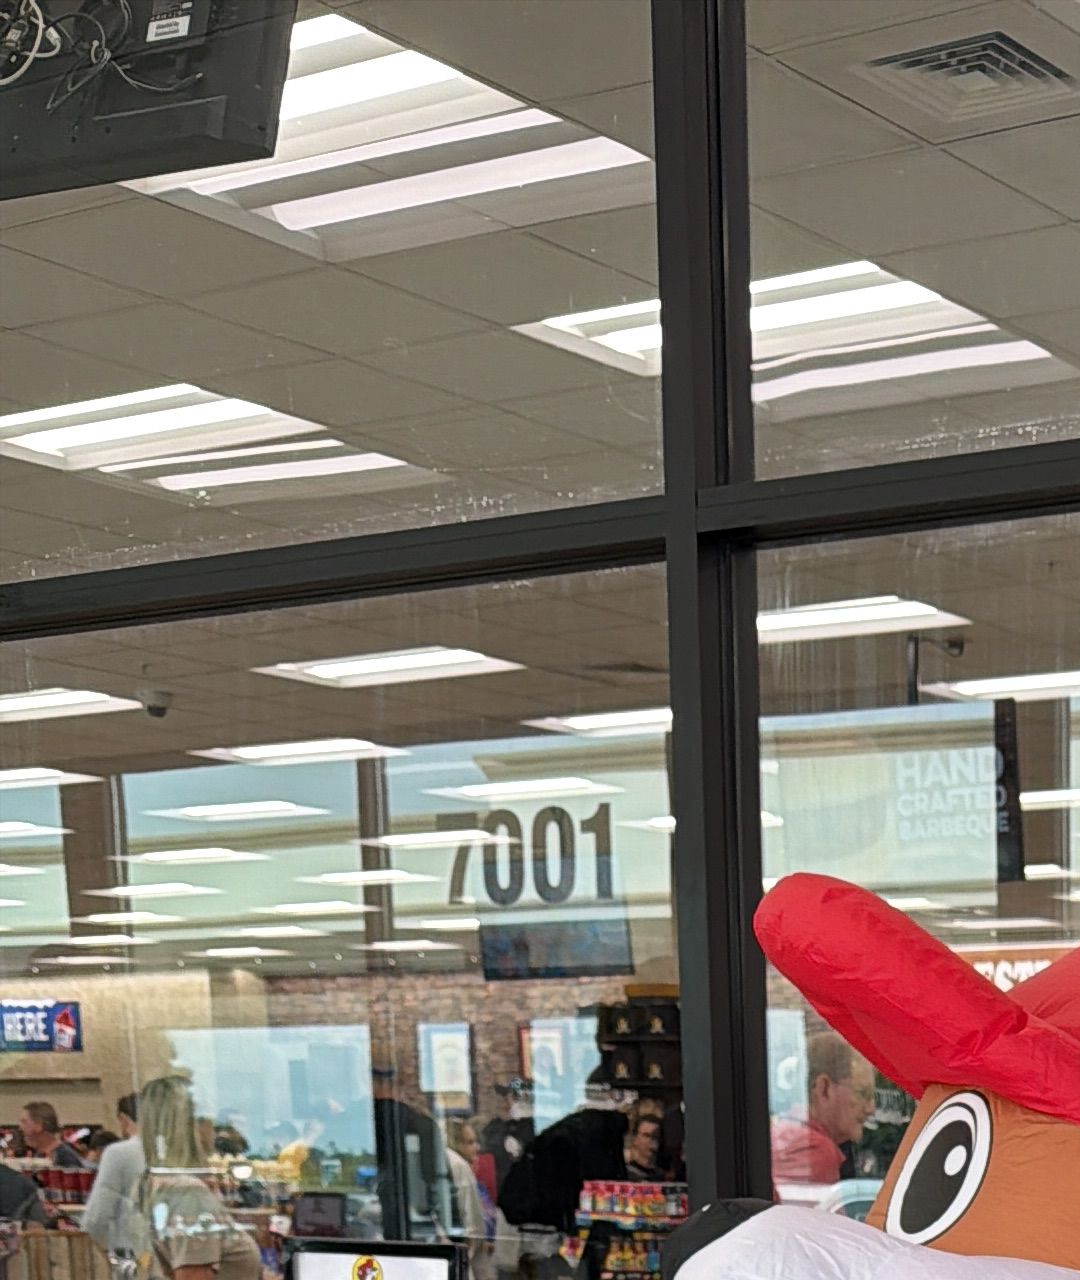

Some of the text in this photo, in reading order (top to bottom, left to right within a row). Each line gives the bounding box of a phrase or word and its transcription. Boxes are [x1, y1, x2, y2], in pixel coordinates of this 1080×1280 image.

[896, 746, 1005, 790] HAND
[898, 785, 1008, 816] CRAFTED
[900, 811, 1009, 840] BARBEQUE
[436, 803, 613, 904] 7001
